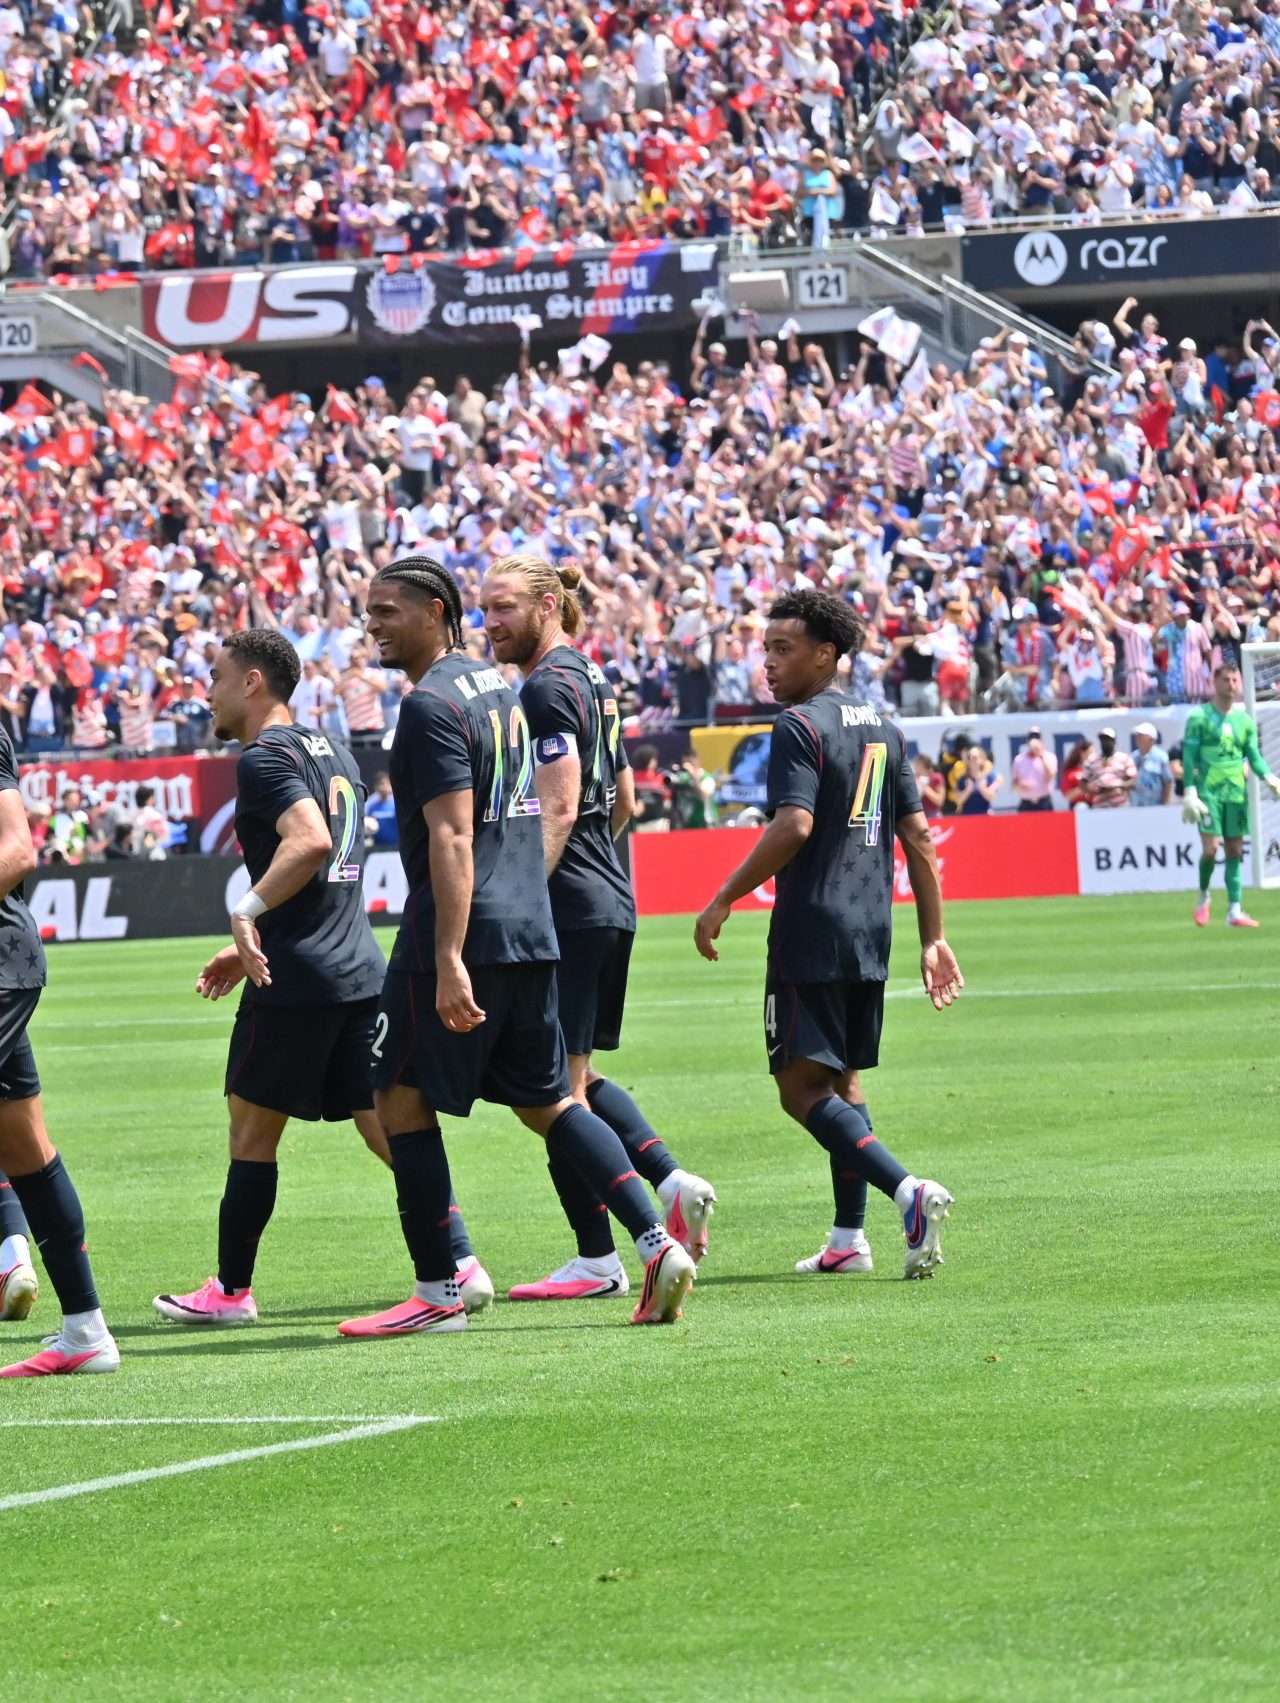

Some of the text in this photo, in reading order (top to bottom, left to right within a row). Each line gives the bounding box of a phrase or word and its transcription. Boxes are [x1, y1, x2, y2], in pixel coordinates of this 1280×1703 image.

[1080, 235, 1169, 270] razr
[156, 266, 359, 347] US
[546, 293, 674, 319] Siempre
[804, 275, 842, 298] 121
[483, 705, 541, 822] 12
[848, 742, 887, 846] 4
[328, 775, 360, 882] 2
[1095, 842, 1194, 872] BANK
[31, 876, 130, 941] AL
[766, 993, 777, 1038] 4
